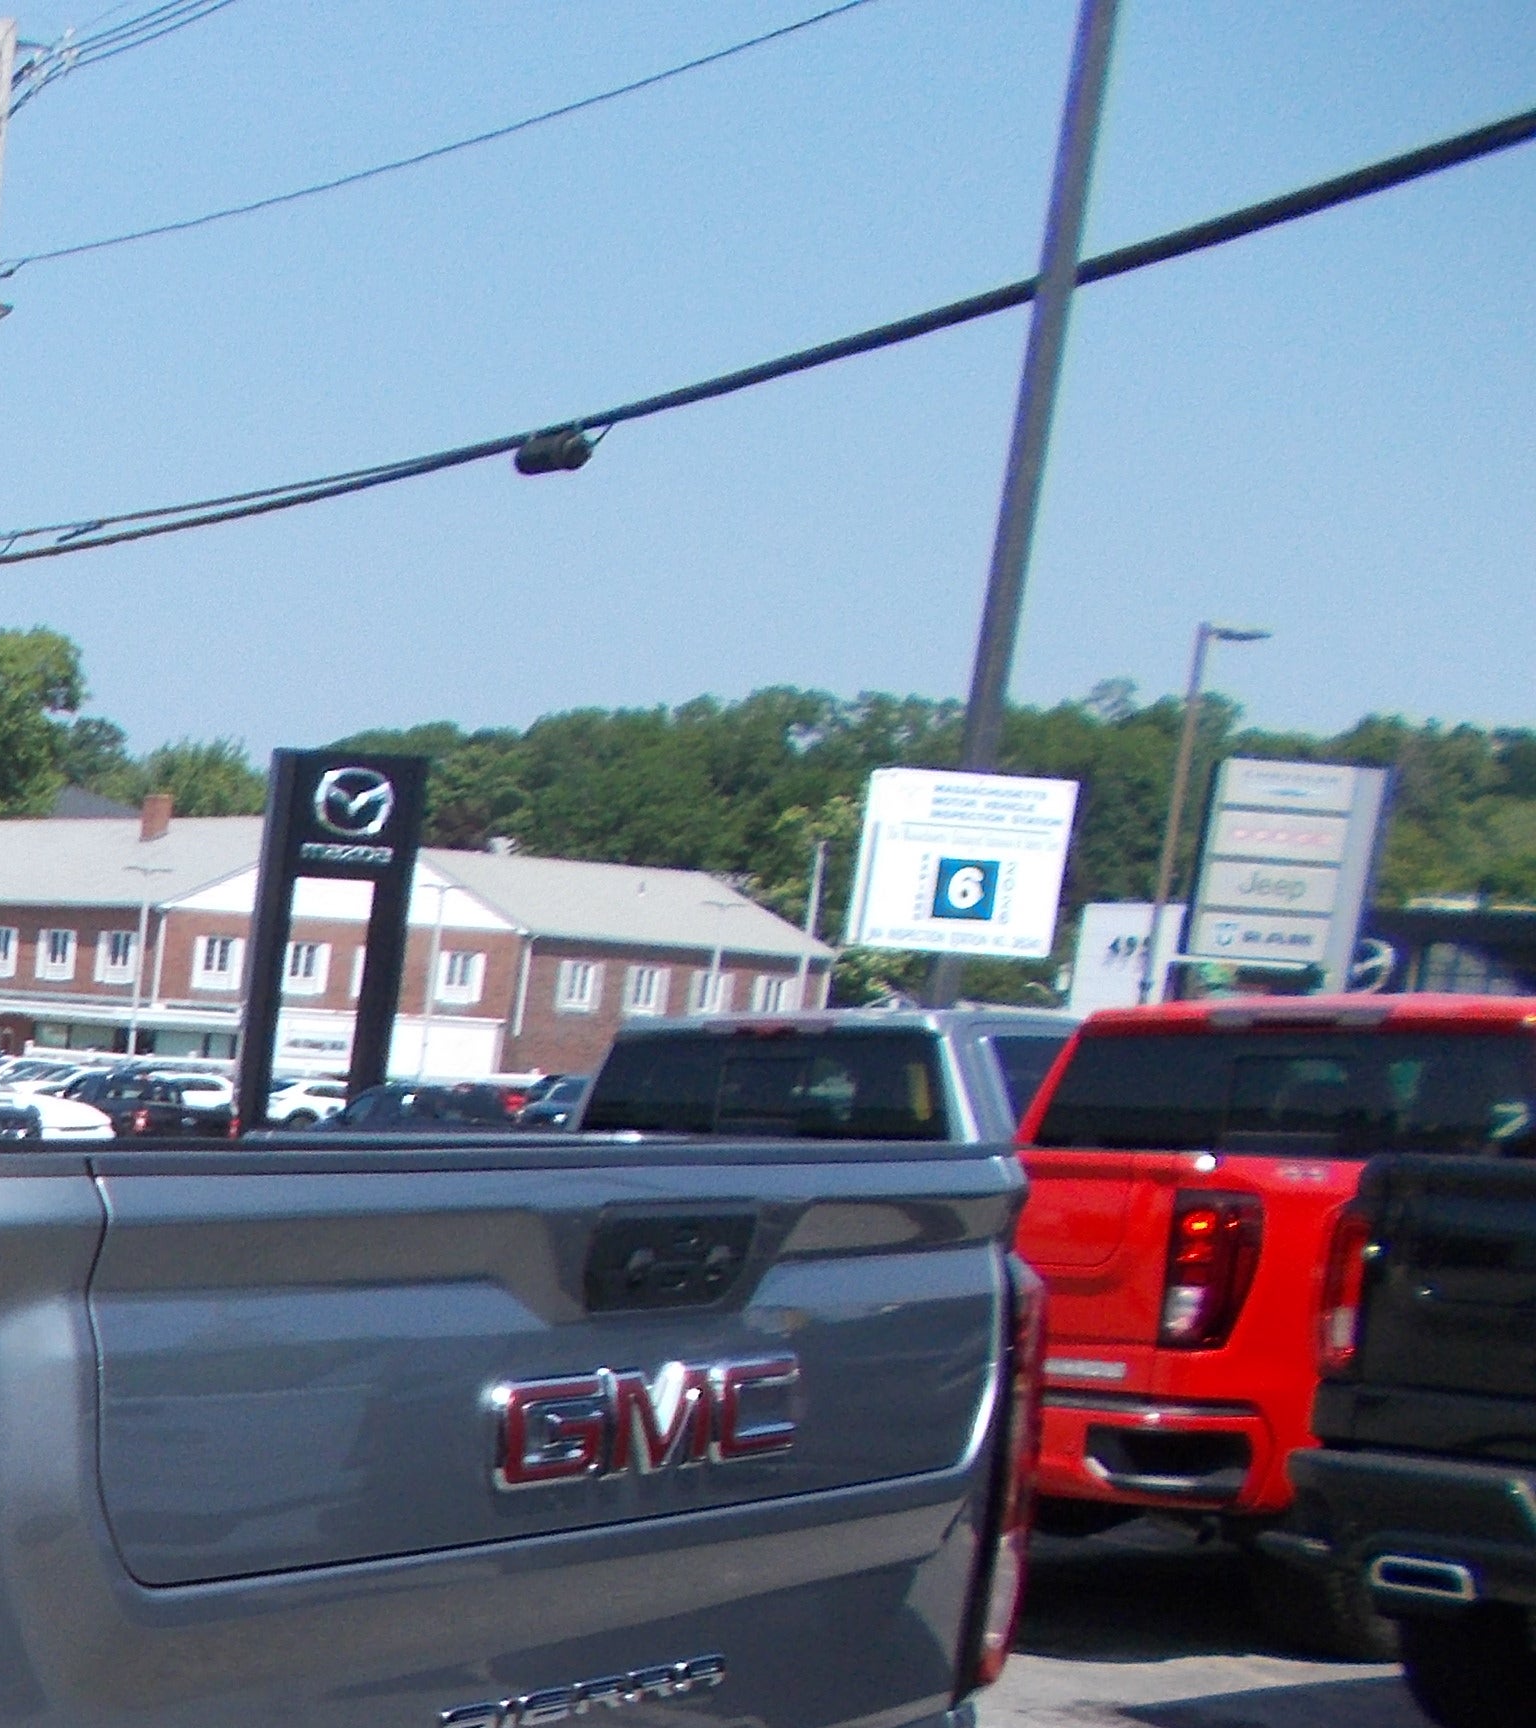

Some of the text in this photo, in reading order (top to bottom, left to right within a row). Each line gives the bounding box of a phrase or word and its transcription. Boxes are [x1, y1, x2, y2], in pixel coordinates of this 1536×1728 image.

[947, 865, 986, 910] 6
[1238, 870, 1307, 902] Jeep
[489, 1350, 803, 1493] GMC
